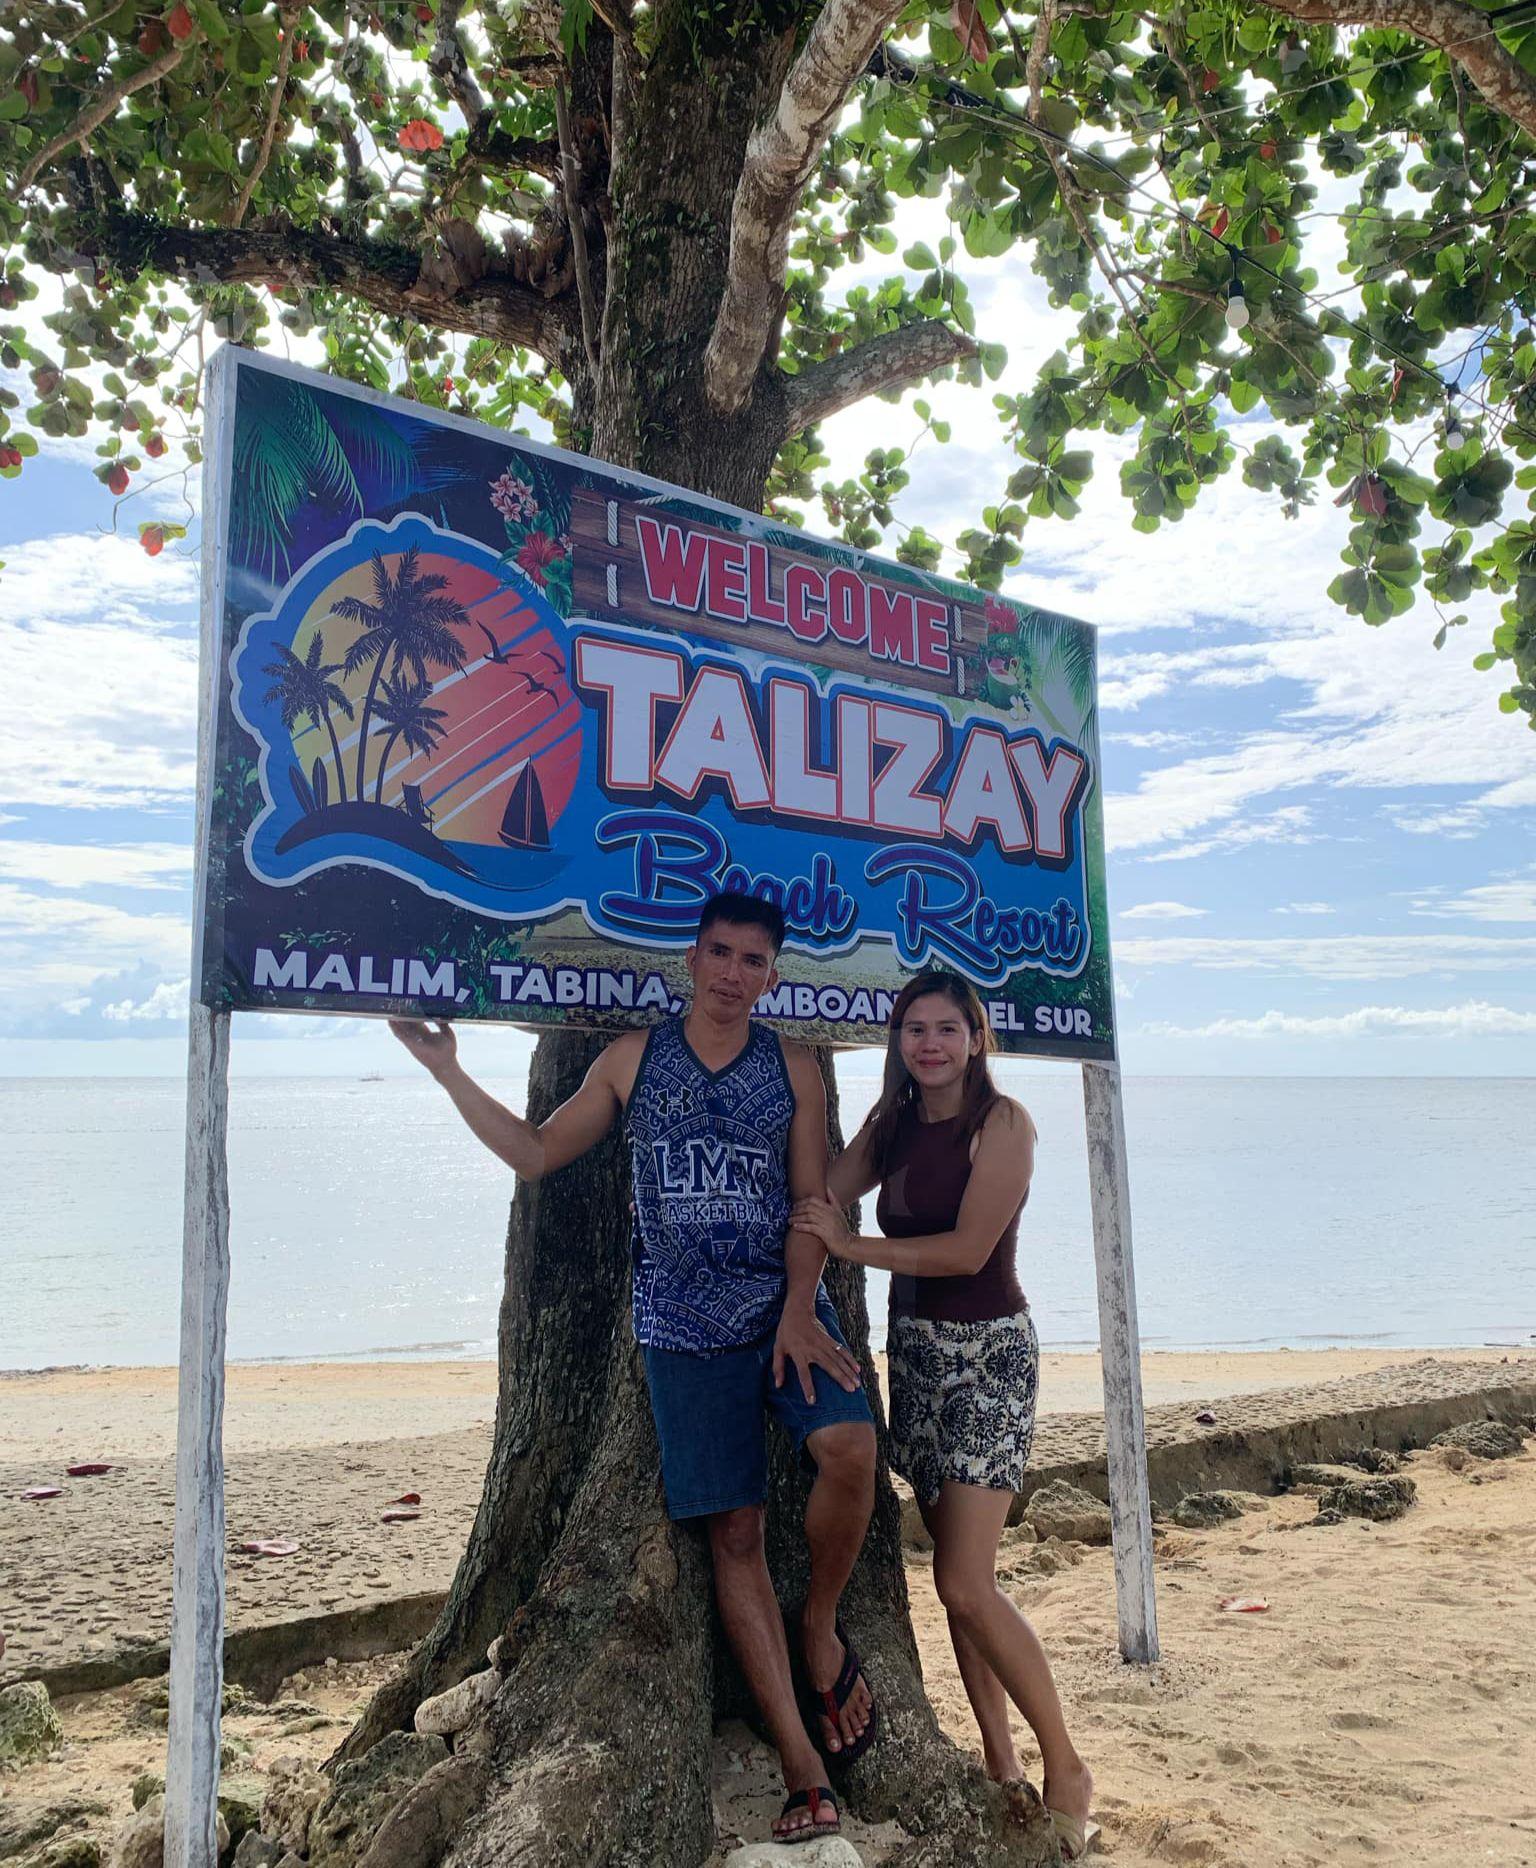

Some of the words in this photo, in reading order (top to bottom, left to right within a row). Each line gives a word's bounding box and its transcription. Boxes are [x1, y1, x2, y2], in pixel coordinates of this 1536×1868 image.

[634, 514, 952, 675] WELCOME
[575, 636, 1085, 858] TALIZAY
[595, 809, 855, 936] Beach
[864, 842, 1081, 970] Resort
[253, 948, 472, 1003] MALIM,
[490, 965, 684, 1014] TABINA,
[980, 1001, 1025, 1031] EL
[1034, 1005, 1092, 1037] SUR
[652, 1139, 770, 1200] LMT
